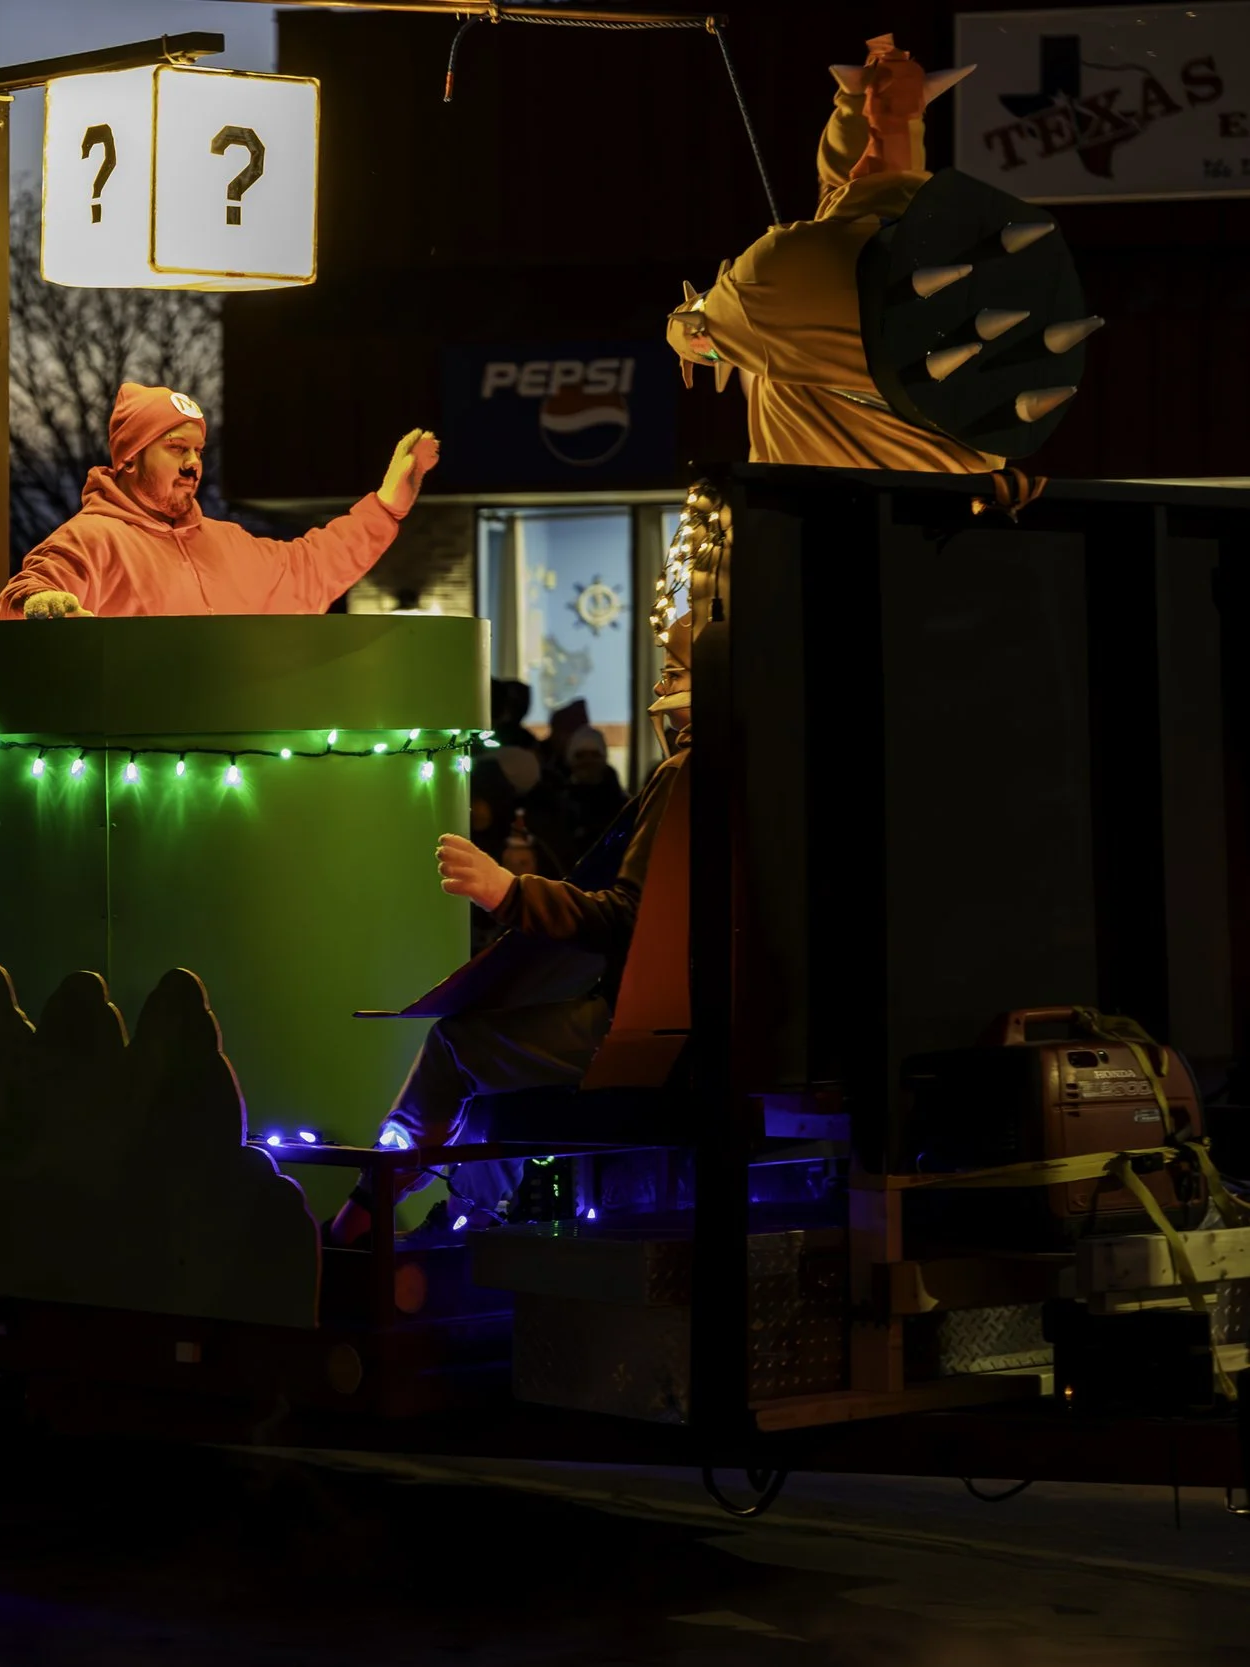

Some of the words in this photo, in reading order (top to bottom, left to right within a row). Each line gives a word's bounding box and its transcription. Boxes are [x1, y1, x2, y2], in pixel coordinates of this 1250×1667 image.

[981, 55, 1225, 172] TEXAS
[80, 122, 117, 225] ?
[210, 124, 266, 226] ?
[481, 357, 636, 399] PEPSI
[1092, 1069, 1137, 1080] HONDA
